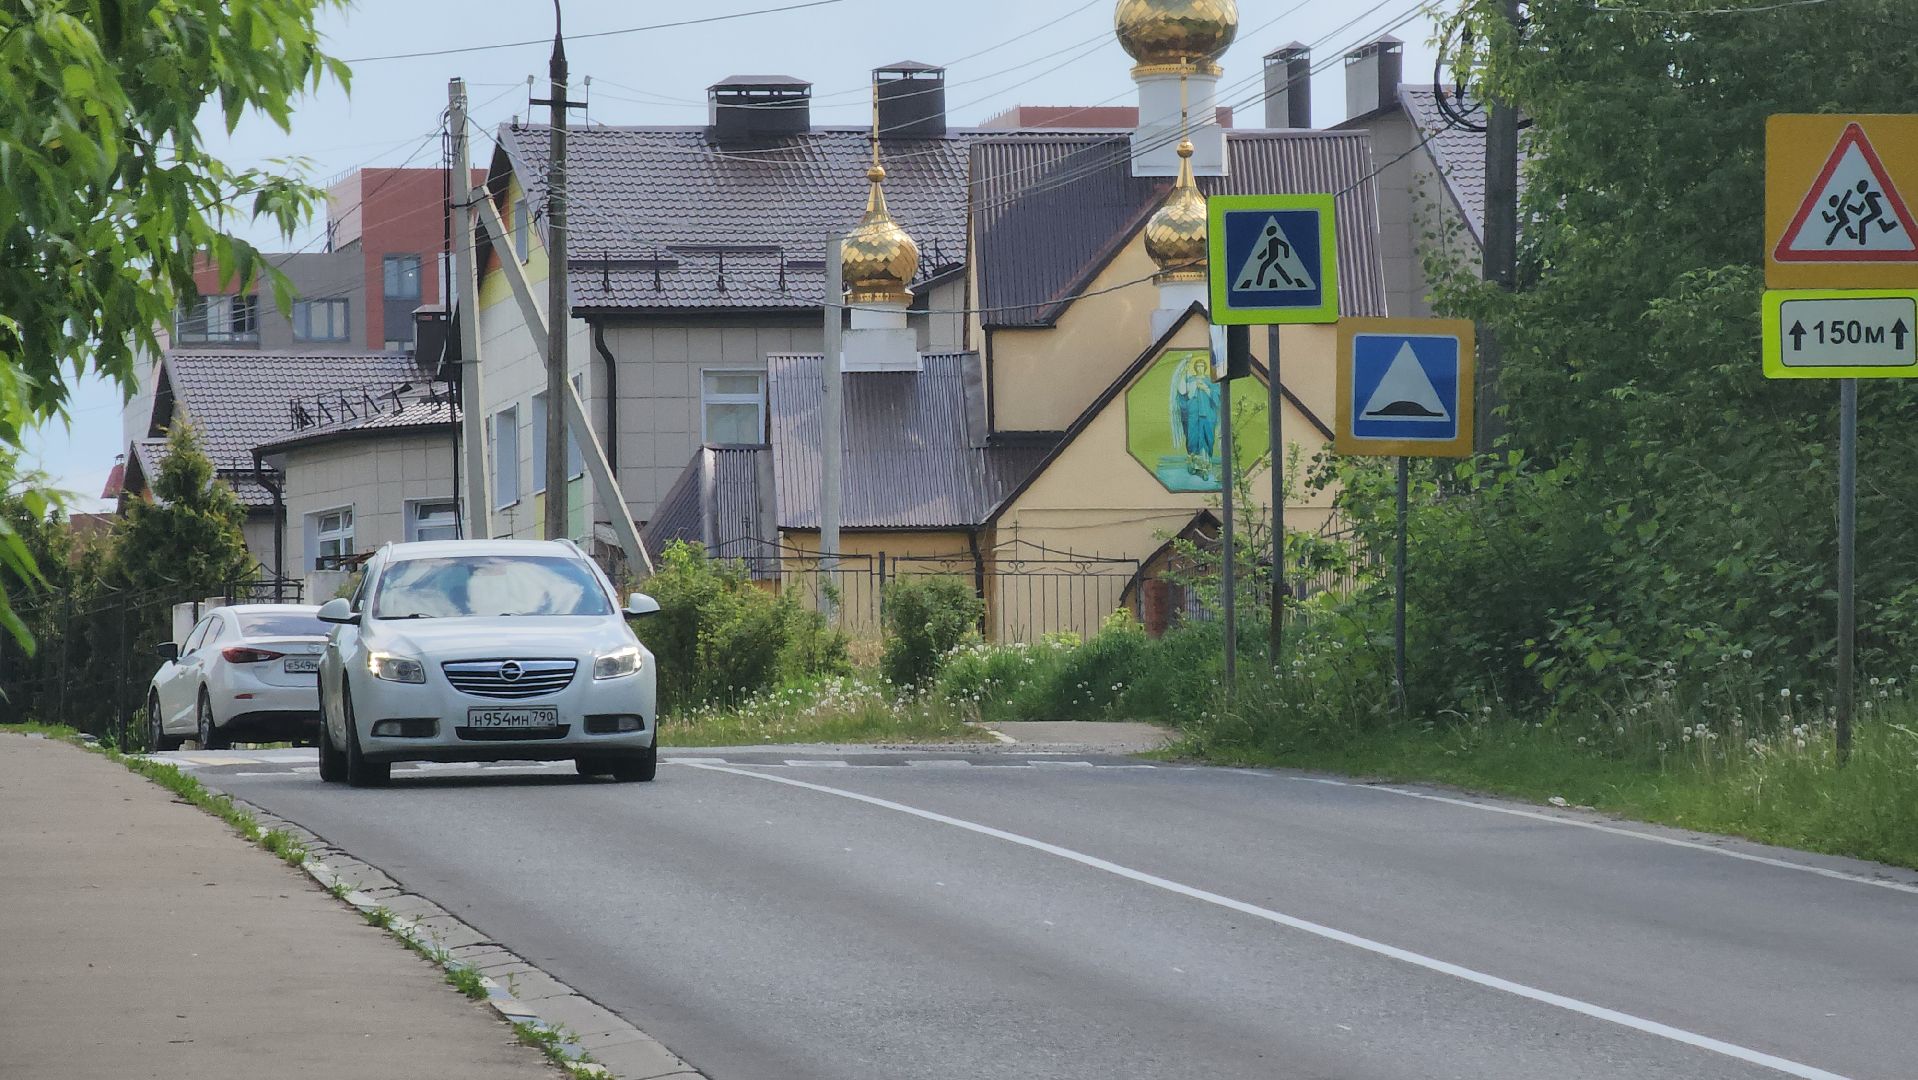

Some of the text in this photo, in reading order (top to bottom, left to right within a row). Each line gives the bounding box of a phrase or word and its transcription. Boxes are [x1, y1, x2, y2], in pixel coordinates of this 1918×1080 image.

[1813, 320, 1885, 344] 150м
[288, 661, 318, 670] Е549М
[474, 711, 553, 726] Н954МН 790
